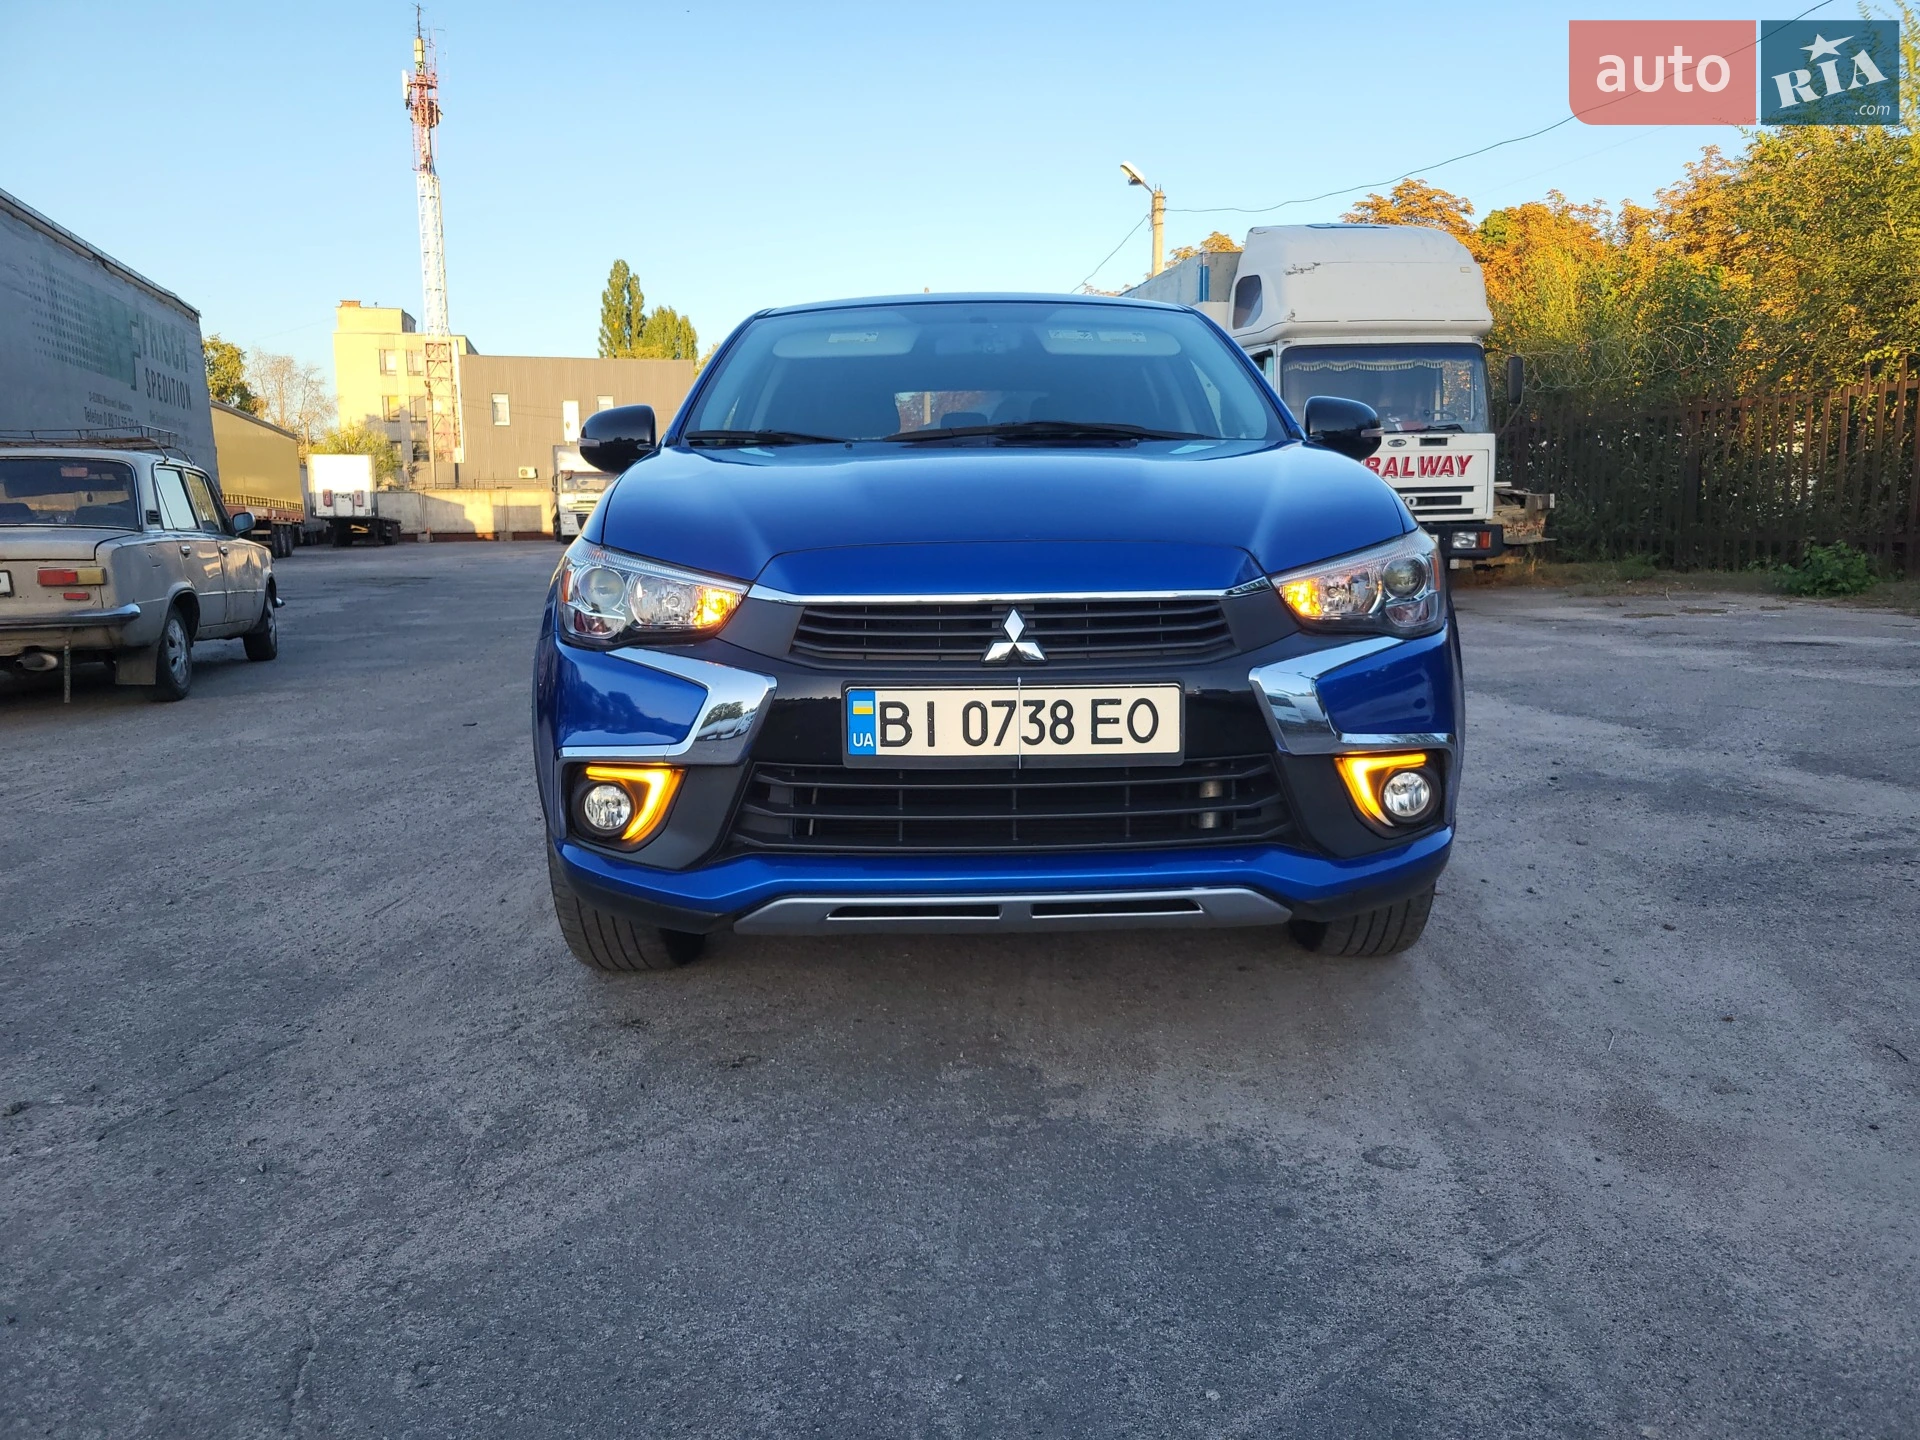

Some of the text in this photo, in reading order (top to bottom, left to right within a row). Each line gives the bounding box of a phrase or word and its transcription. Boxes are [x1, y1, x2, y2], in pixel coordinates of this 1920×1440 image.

[145, 367, 192, 411] SPEDITION
[853, 732, 874, 747] UA
[879, 698, 1159, 748] BI 0738 EO
